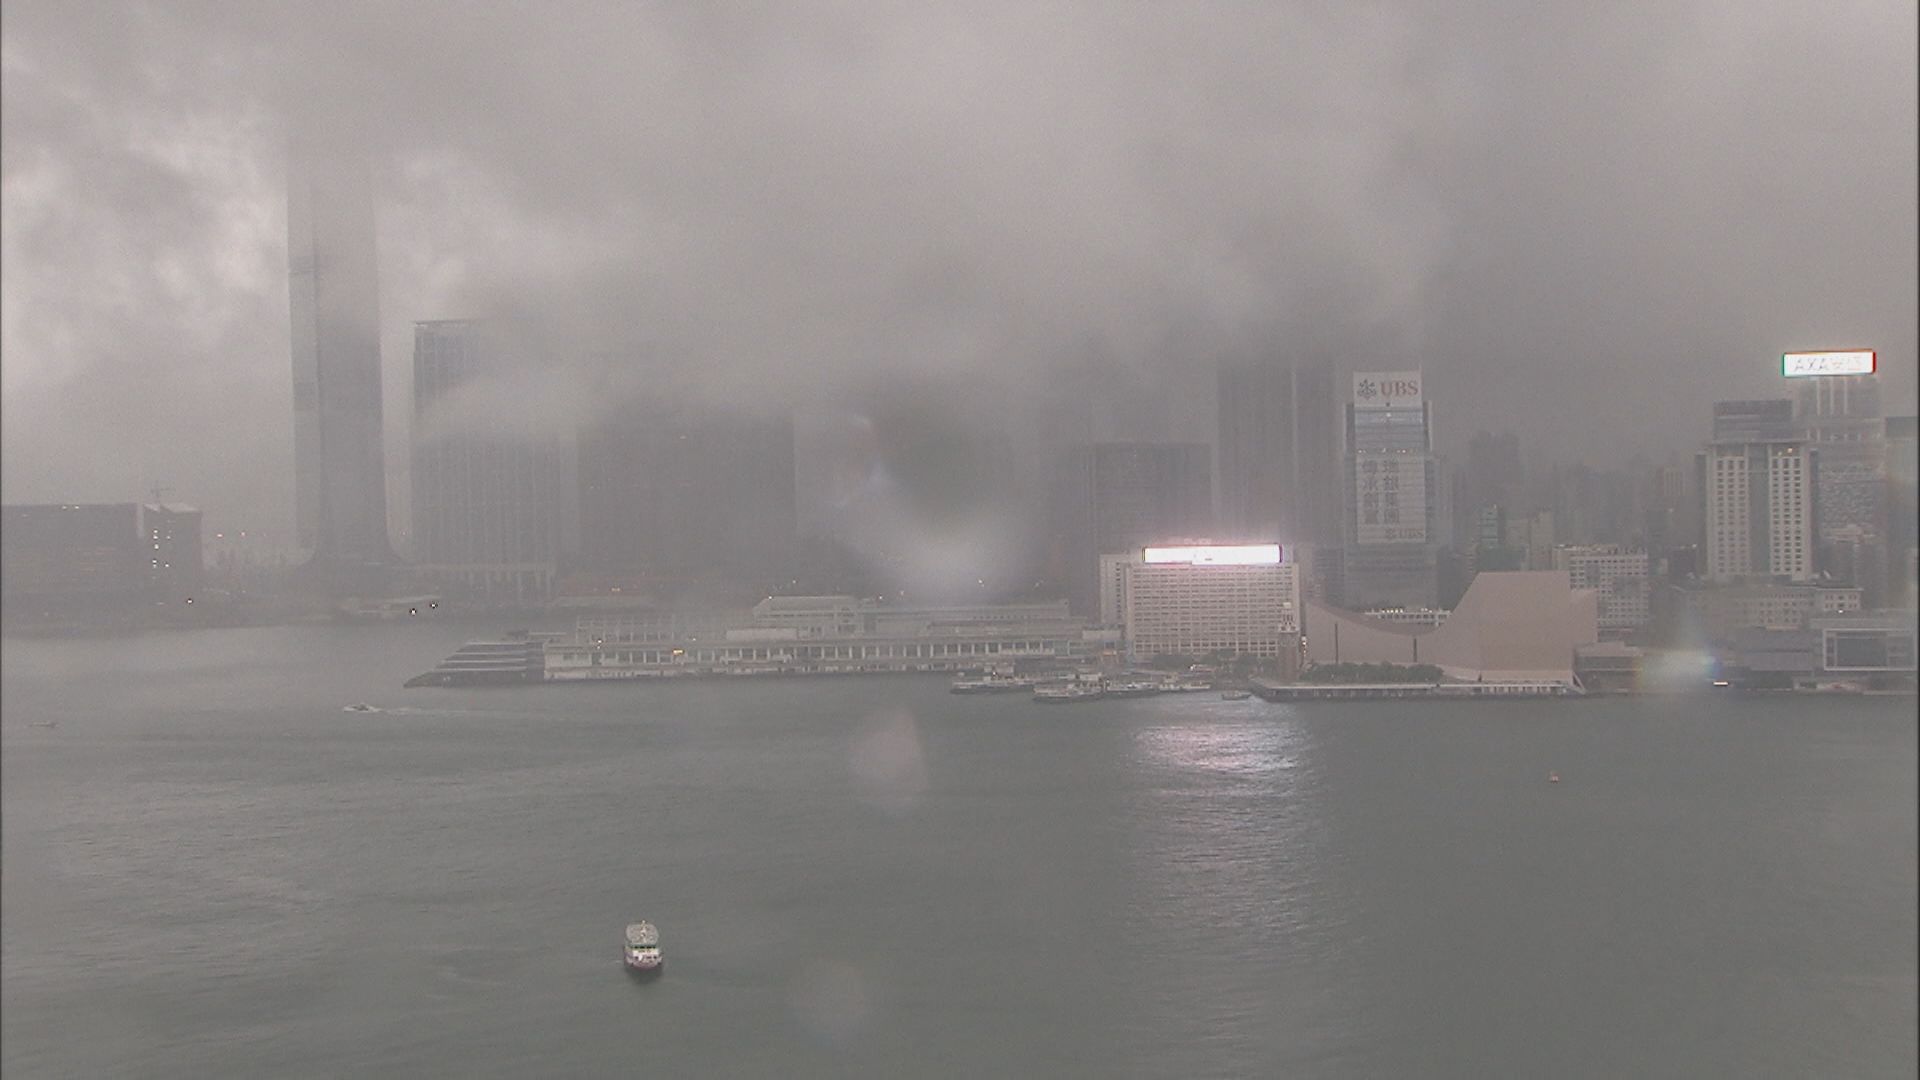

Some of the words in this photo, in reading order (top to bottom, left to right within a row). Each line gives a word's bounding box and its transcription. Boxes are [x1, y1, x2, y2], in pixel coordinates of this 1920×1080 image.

[1793, 356, 1830, 373] AXA
[1380, 379, 1419, 397] UBS
[1399, 528, 1424, 538] UBS
